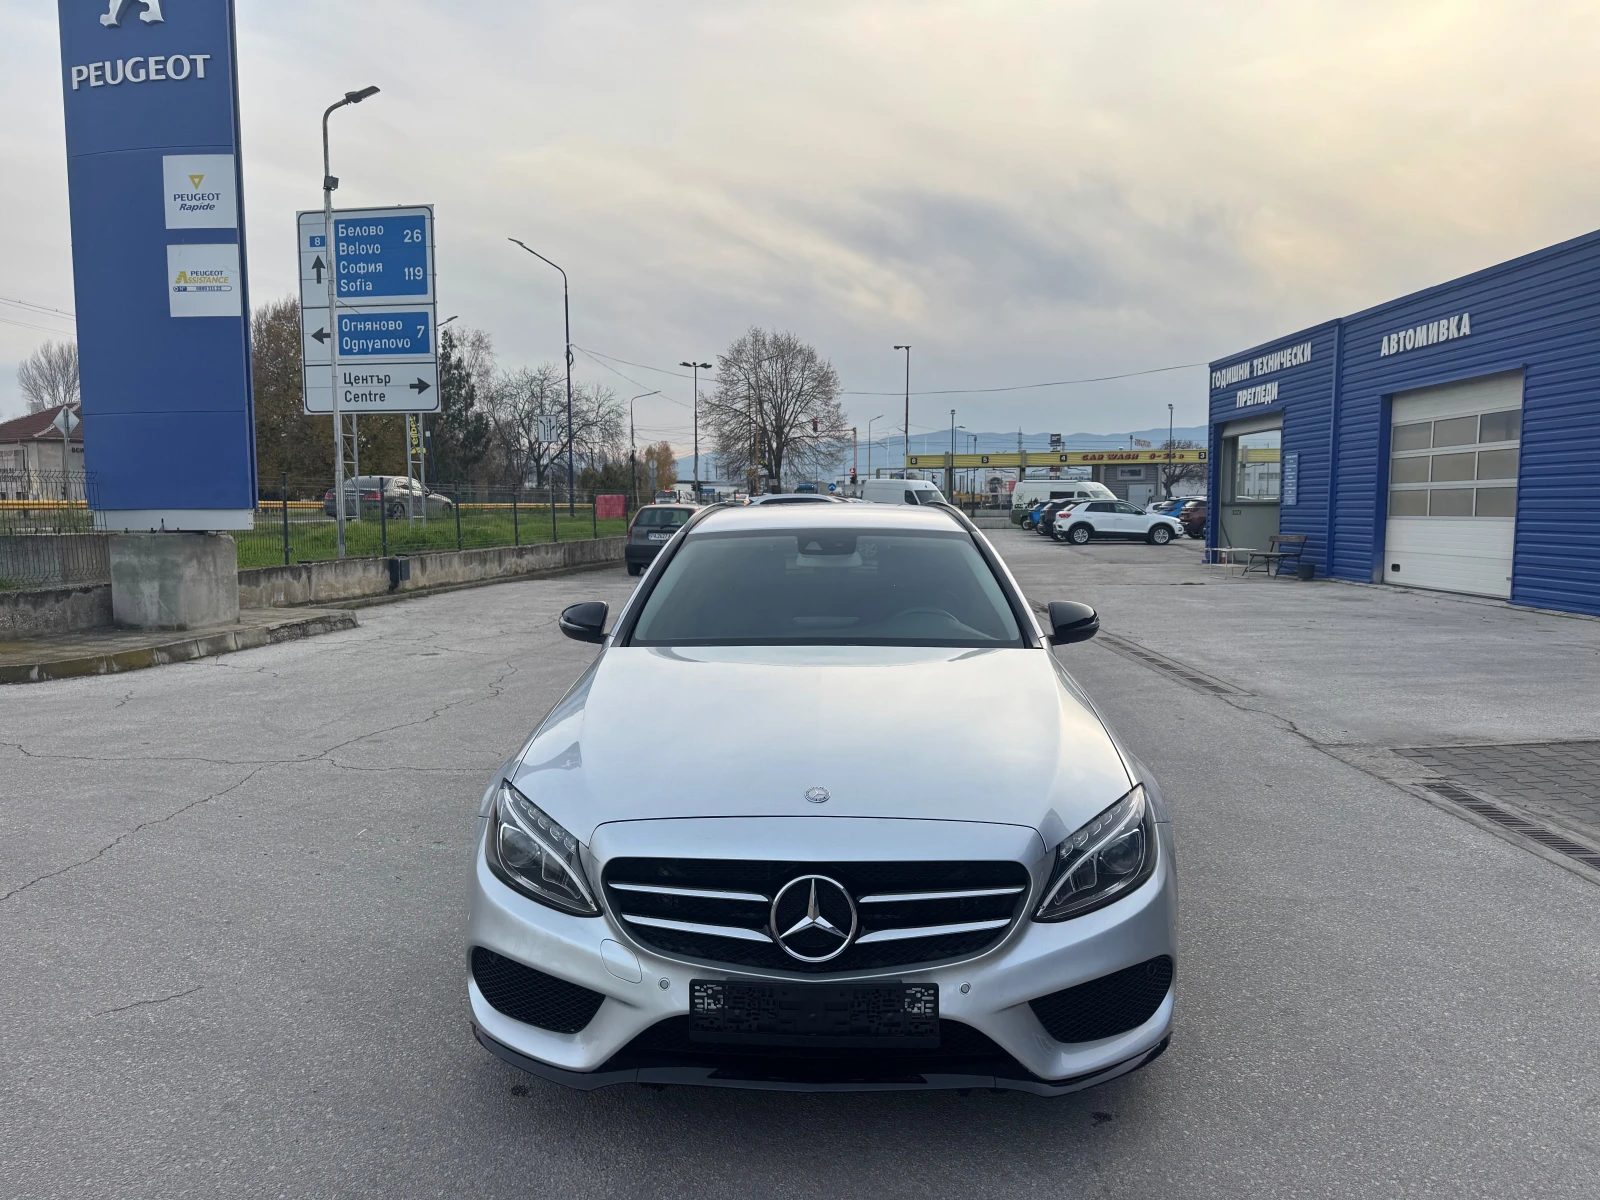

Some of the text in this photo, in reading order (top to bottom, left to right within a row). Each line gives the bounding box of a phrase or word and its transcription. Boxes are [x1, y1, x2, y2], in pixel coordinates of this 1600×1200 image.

[71, 54, 211, 90] PEUGEOT
[173, 193, 221, 202] PEUGEOT
[314, 237, 321, 246] 8
[338, 224, 422, 243] Белово 26
[339, 242, 381, 255] Belovo
[340, 261, 423, 281] София 119
[340, 279, 373, 292] Sofia
[342, 319, 425, 339] Огняново 7
[1380, 312, 1471, 357] АВТОМИВКА
[342, 336, 411, 352] Ognyanovo
[1211, 341, 1312, 389] ГОДИШНИ ТЕХНИЧЕСКИ
[343, 372, 391, 387] Център
[344, 390, 386, 403] Centre
[1236, 381, 1279, 408] ПРЕГЛЕДИ
[1082, 453, 1105, 461] CAR
